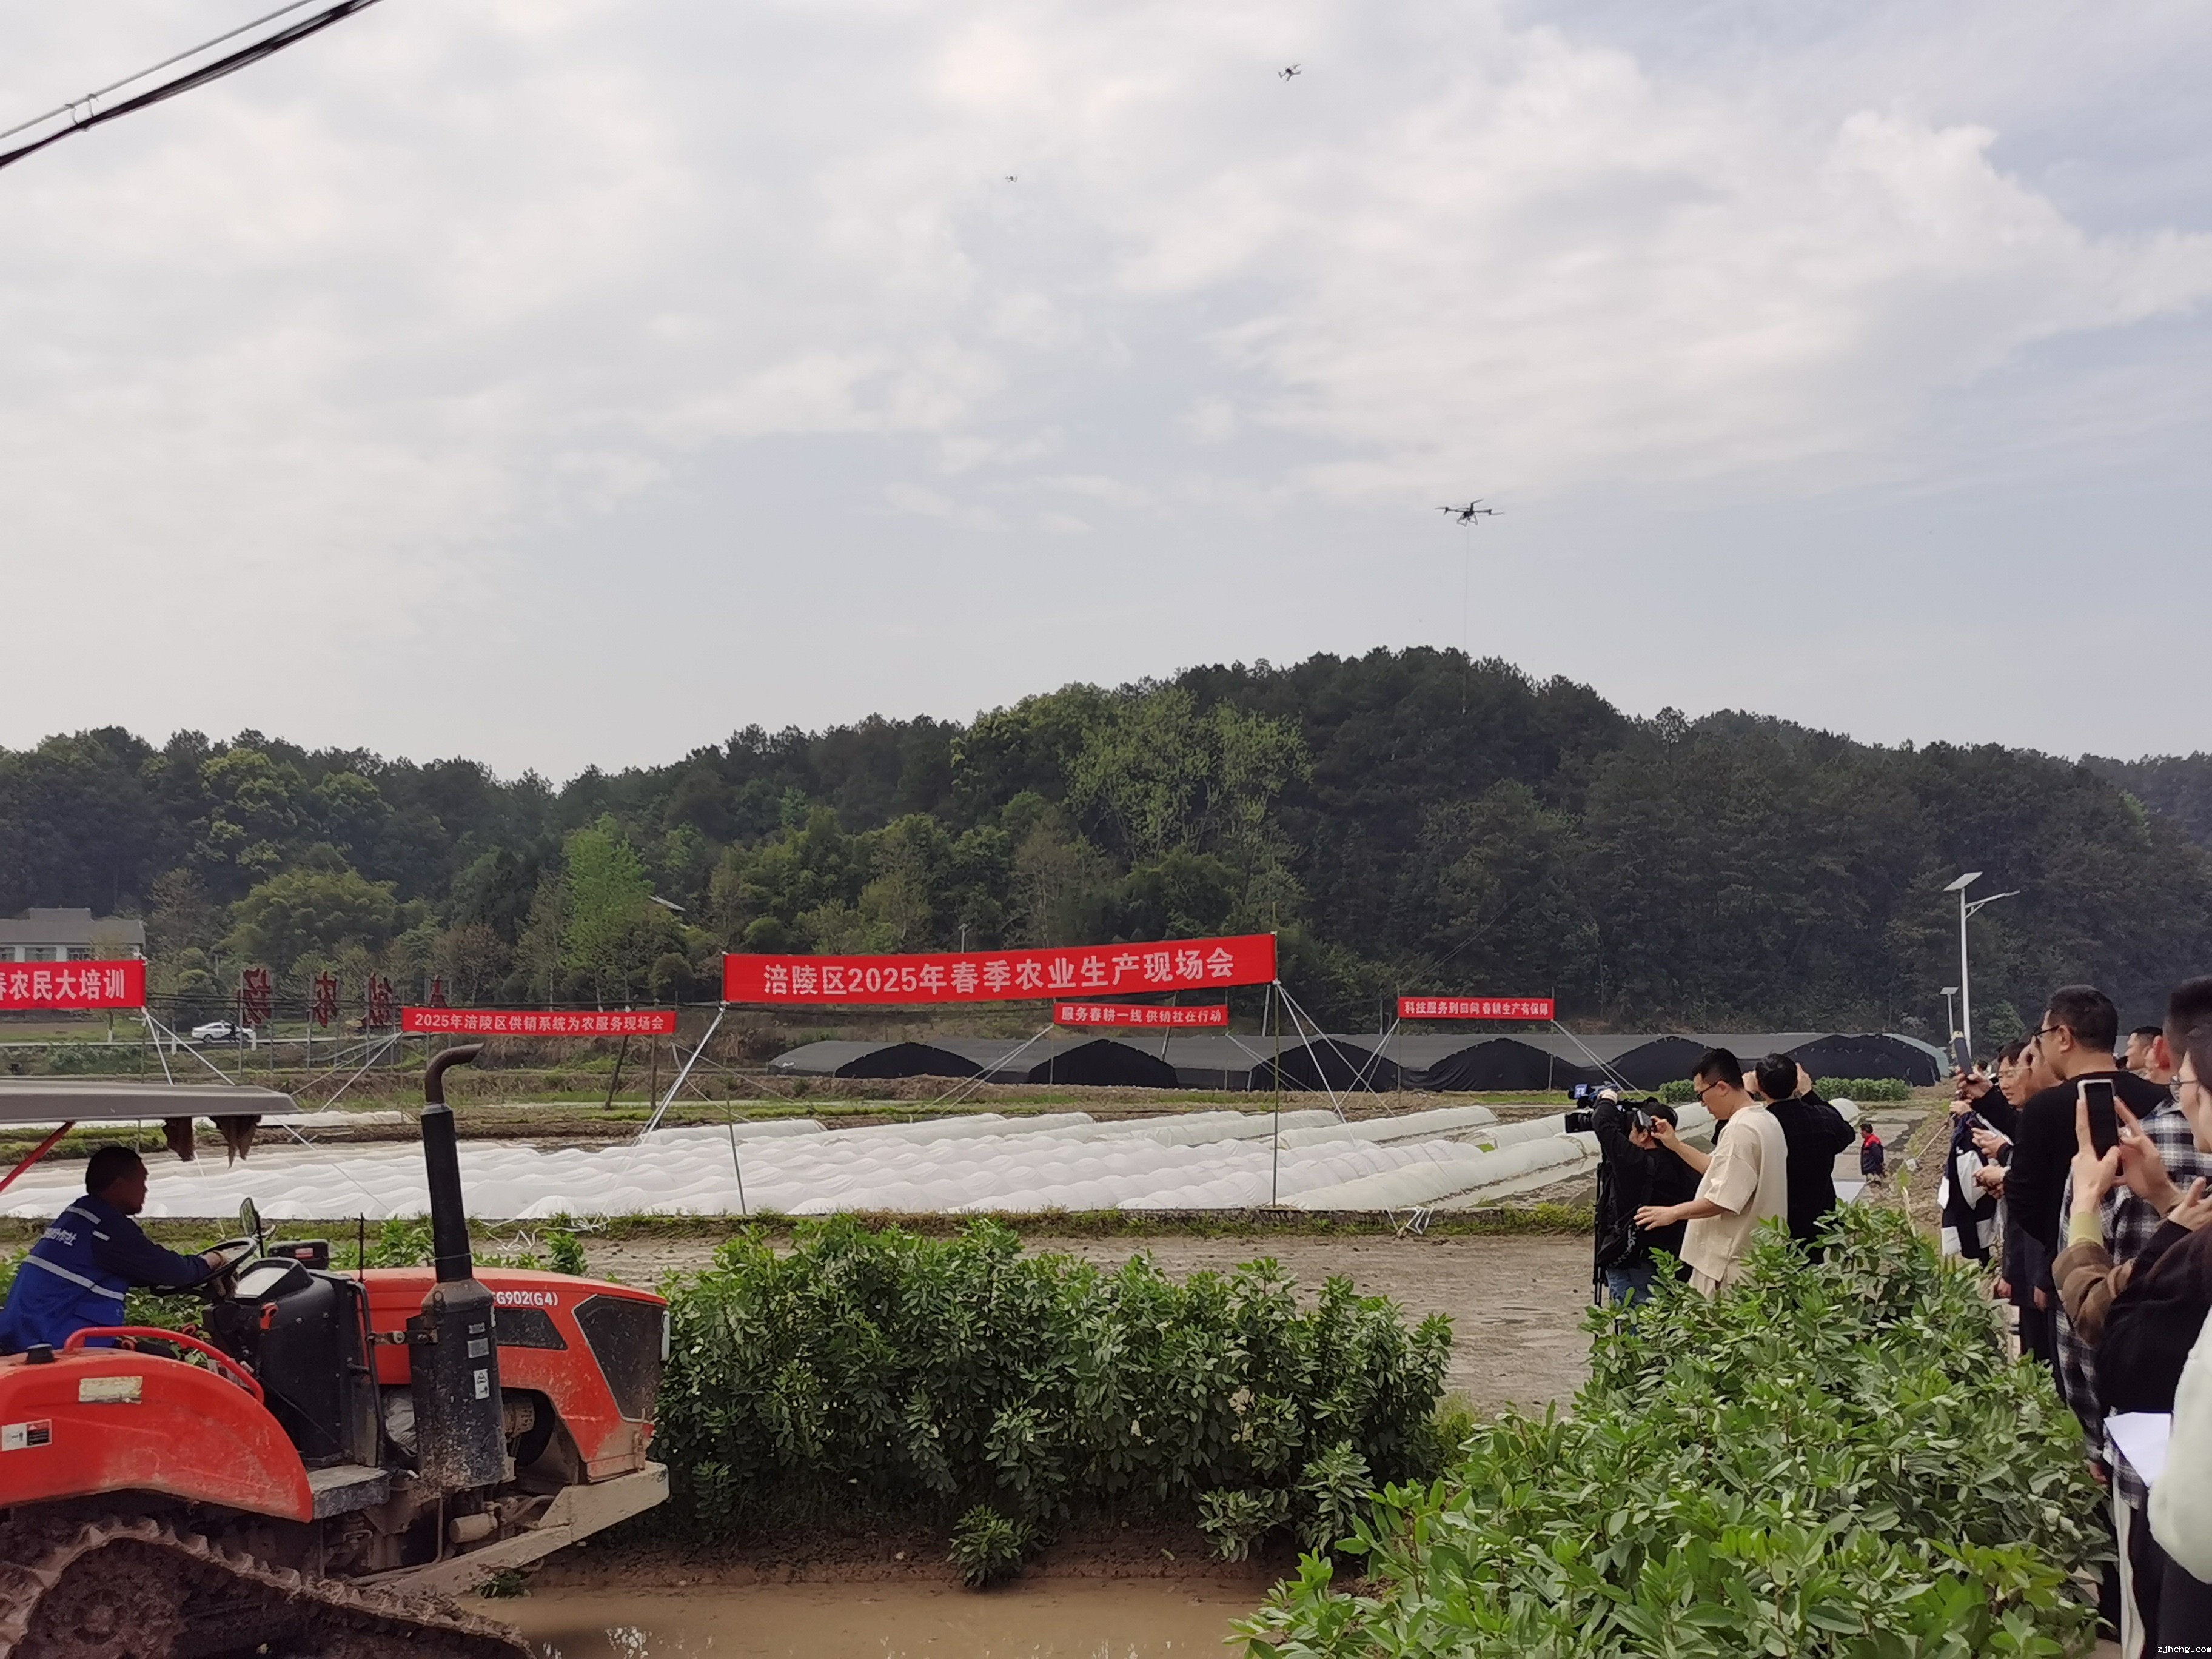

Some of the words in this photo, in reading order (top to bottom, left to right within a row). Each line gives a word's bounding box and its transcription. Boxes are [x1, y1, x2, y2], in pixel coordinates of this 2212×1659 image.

[764, 947, 1234, 995] 涪陵区2025年春季农业生产现场会
[415, 1014, 664, 1031] 2025年涪陵区供销系统为农服务现场会
[1061, 1007, 1142, 1022] 服务春耕一线
[1146, 1009, 1221, 1024] 供销社在行动
